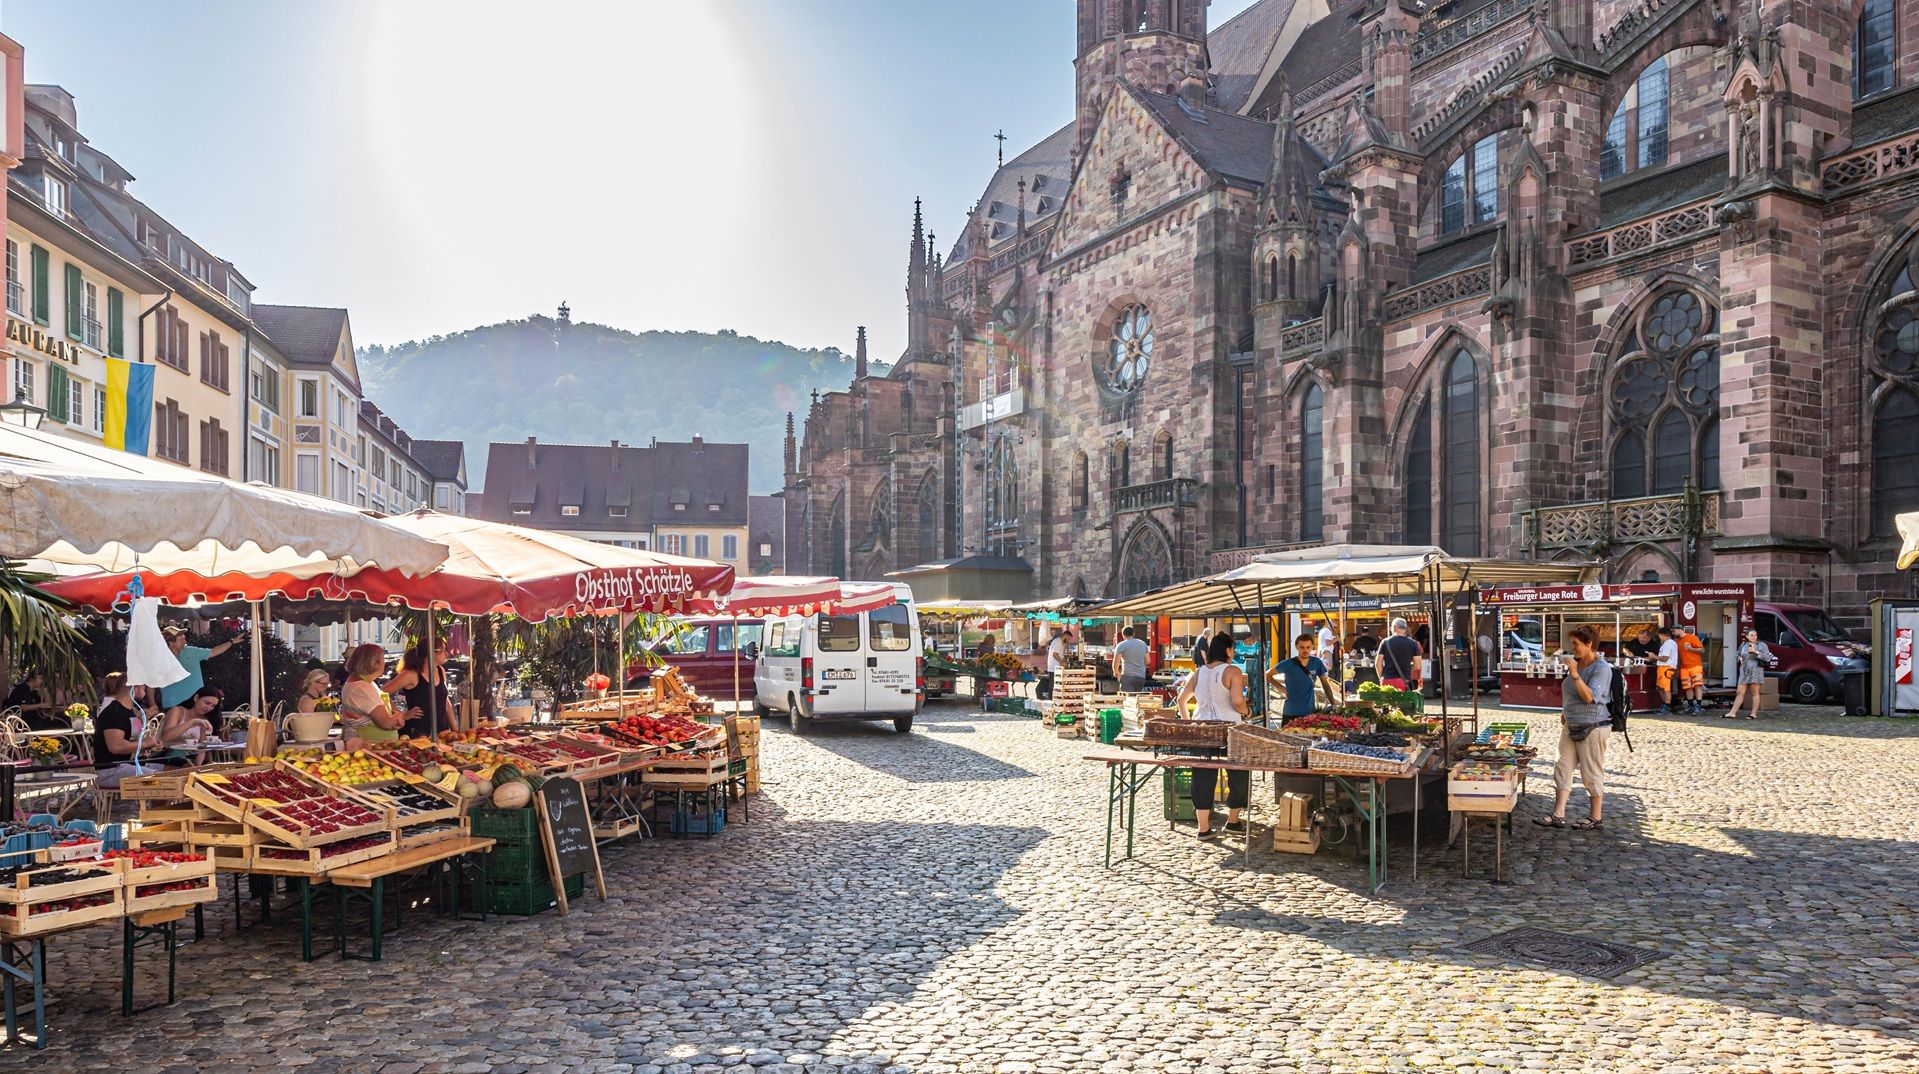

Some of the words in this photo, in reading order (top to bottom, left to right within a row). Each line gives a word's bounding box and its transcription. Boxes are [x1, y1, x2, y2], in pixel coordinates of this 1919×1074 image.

[576, 568, 633, 602] Obsthof
[635, 567, 693, 595] Schätzle
[1503, 592, 1538, 601] Freiburger
[1540, 591, 1560, 600] Lange
[1561, 590, 1578, 598] Rote
